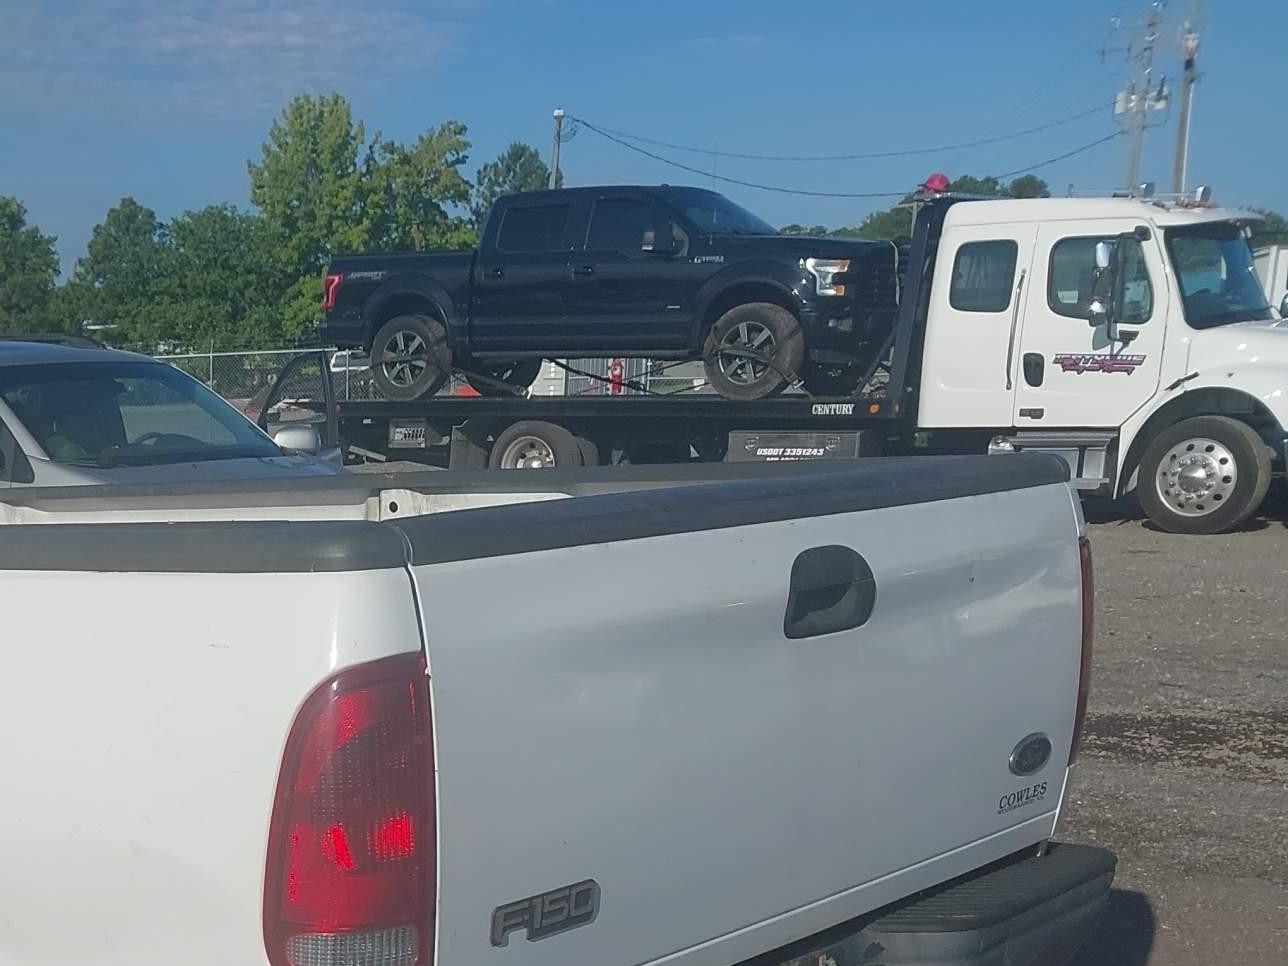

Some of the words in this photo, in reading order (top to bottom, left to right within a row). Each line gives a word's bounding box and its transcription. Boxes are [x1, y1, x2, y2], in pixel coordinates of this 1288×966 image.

[811, 403, 855, 415] CENTURY
[756, 447, 784, 456] USDOT
[998, 781, 1048, 810] COWLES
